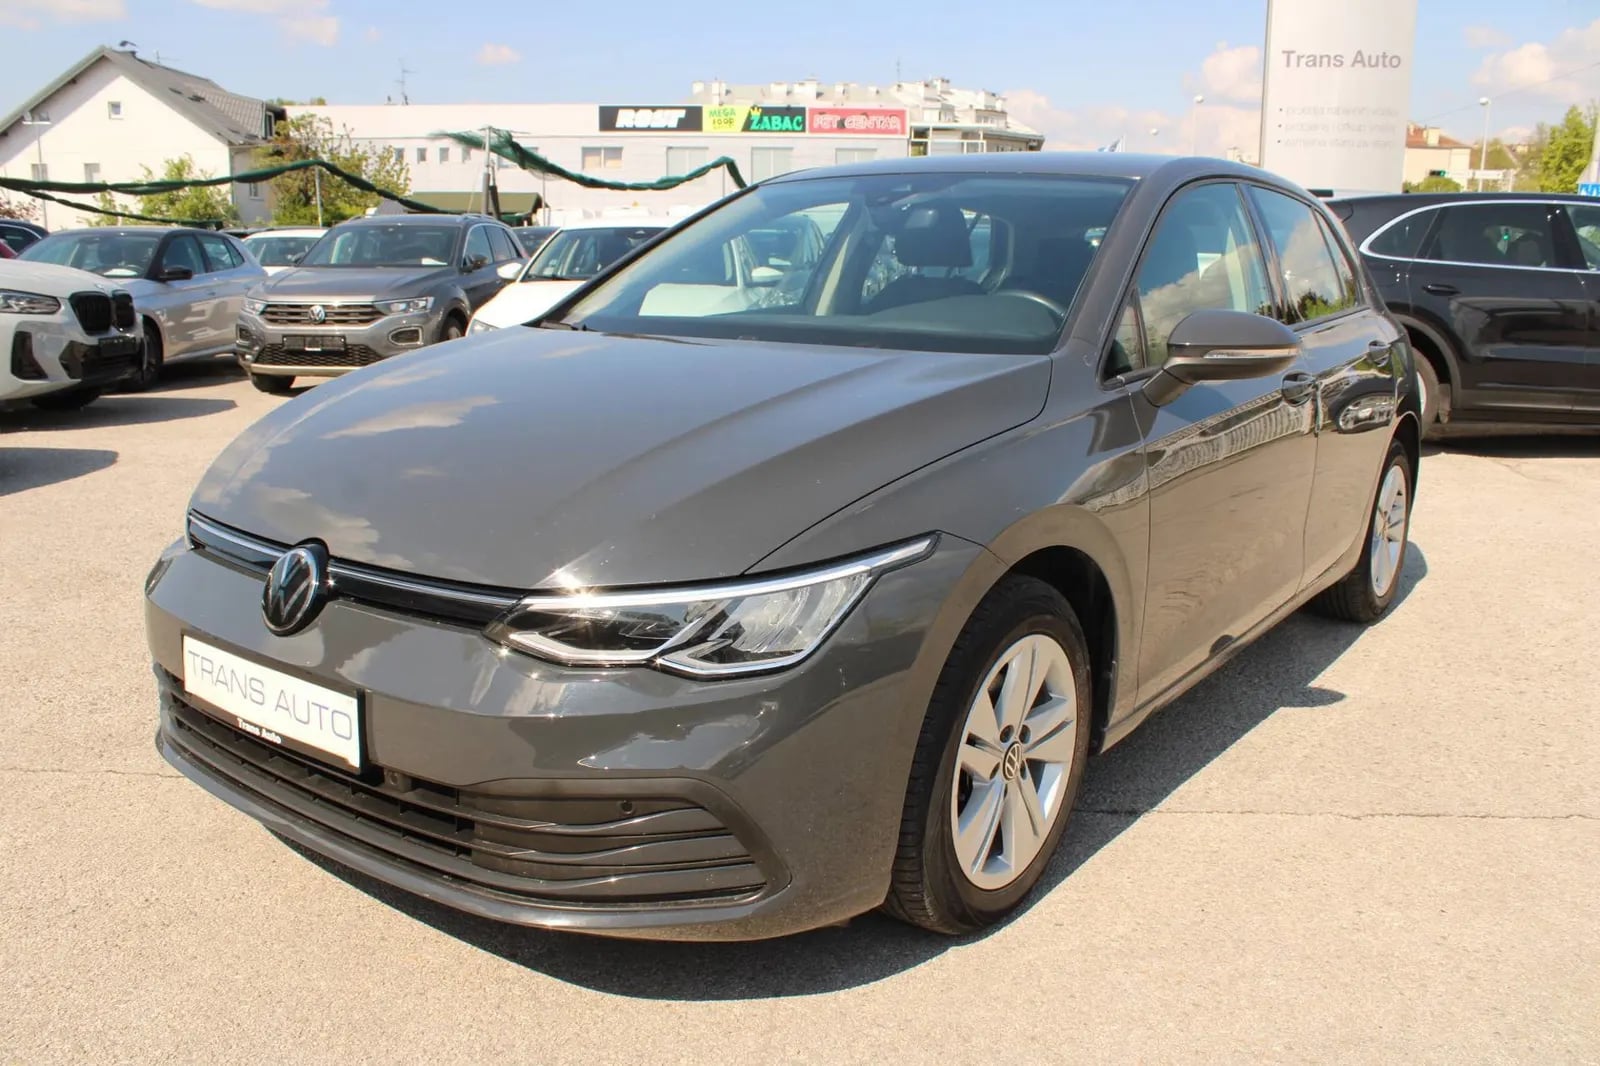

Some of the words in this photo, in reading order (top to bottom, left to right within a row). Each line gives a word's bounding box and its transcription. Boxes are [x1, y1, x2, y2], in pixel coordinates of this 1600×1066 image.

[1281, 49, 1345, 68] Trans
[1350, 49, 1402, 69] Auto
[187, 649, 266, 706] TRANS
[274, 689, 353, 741] AUTO
